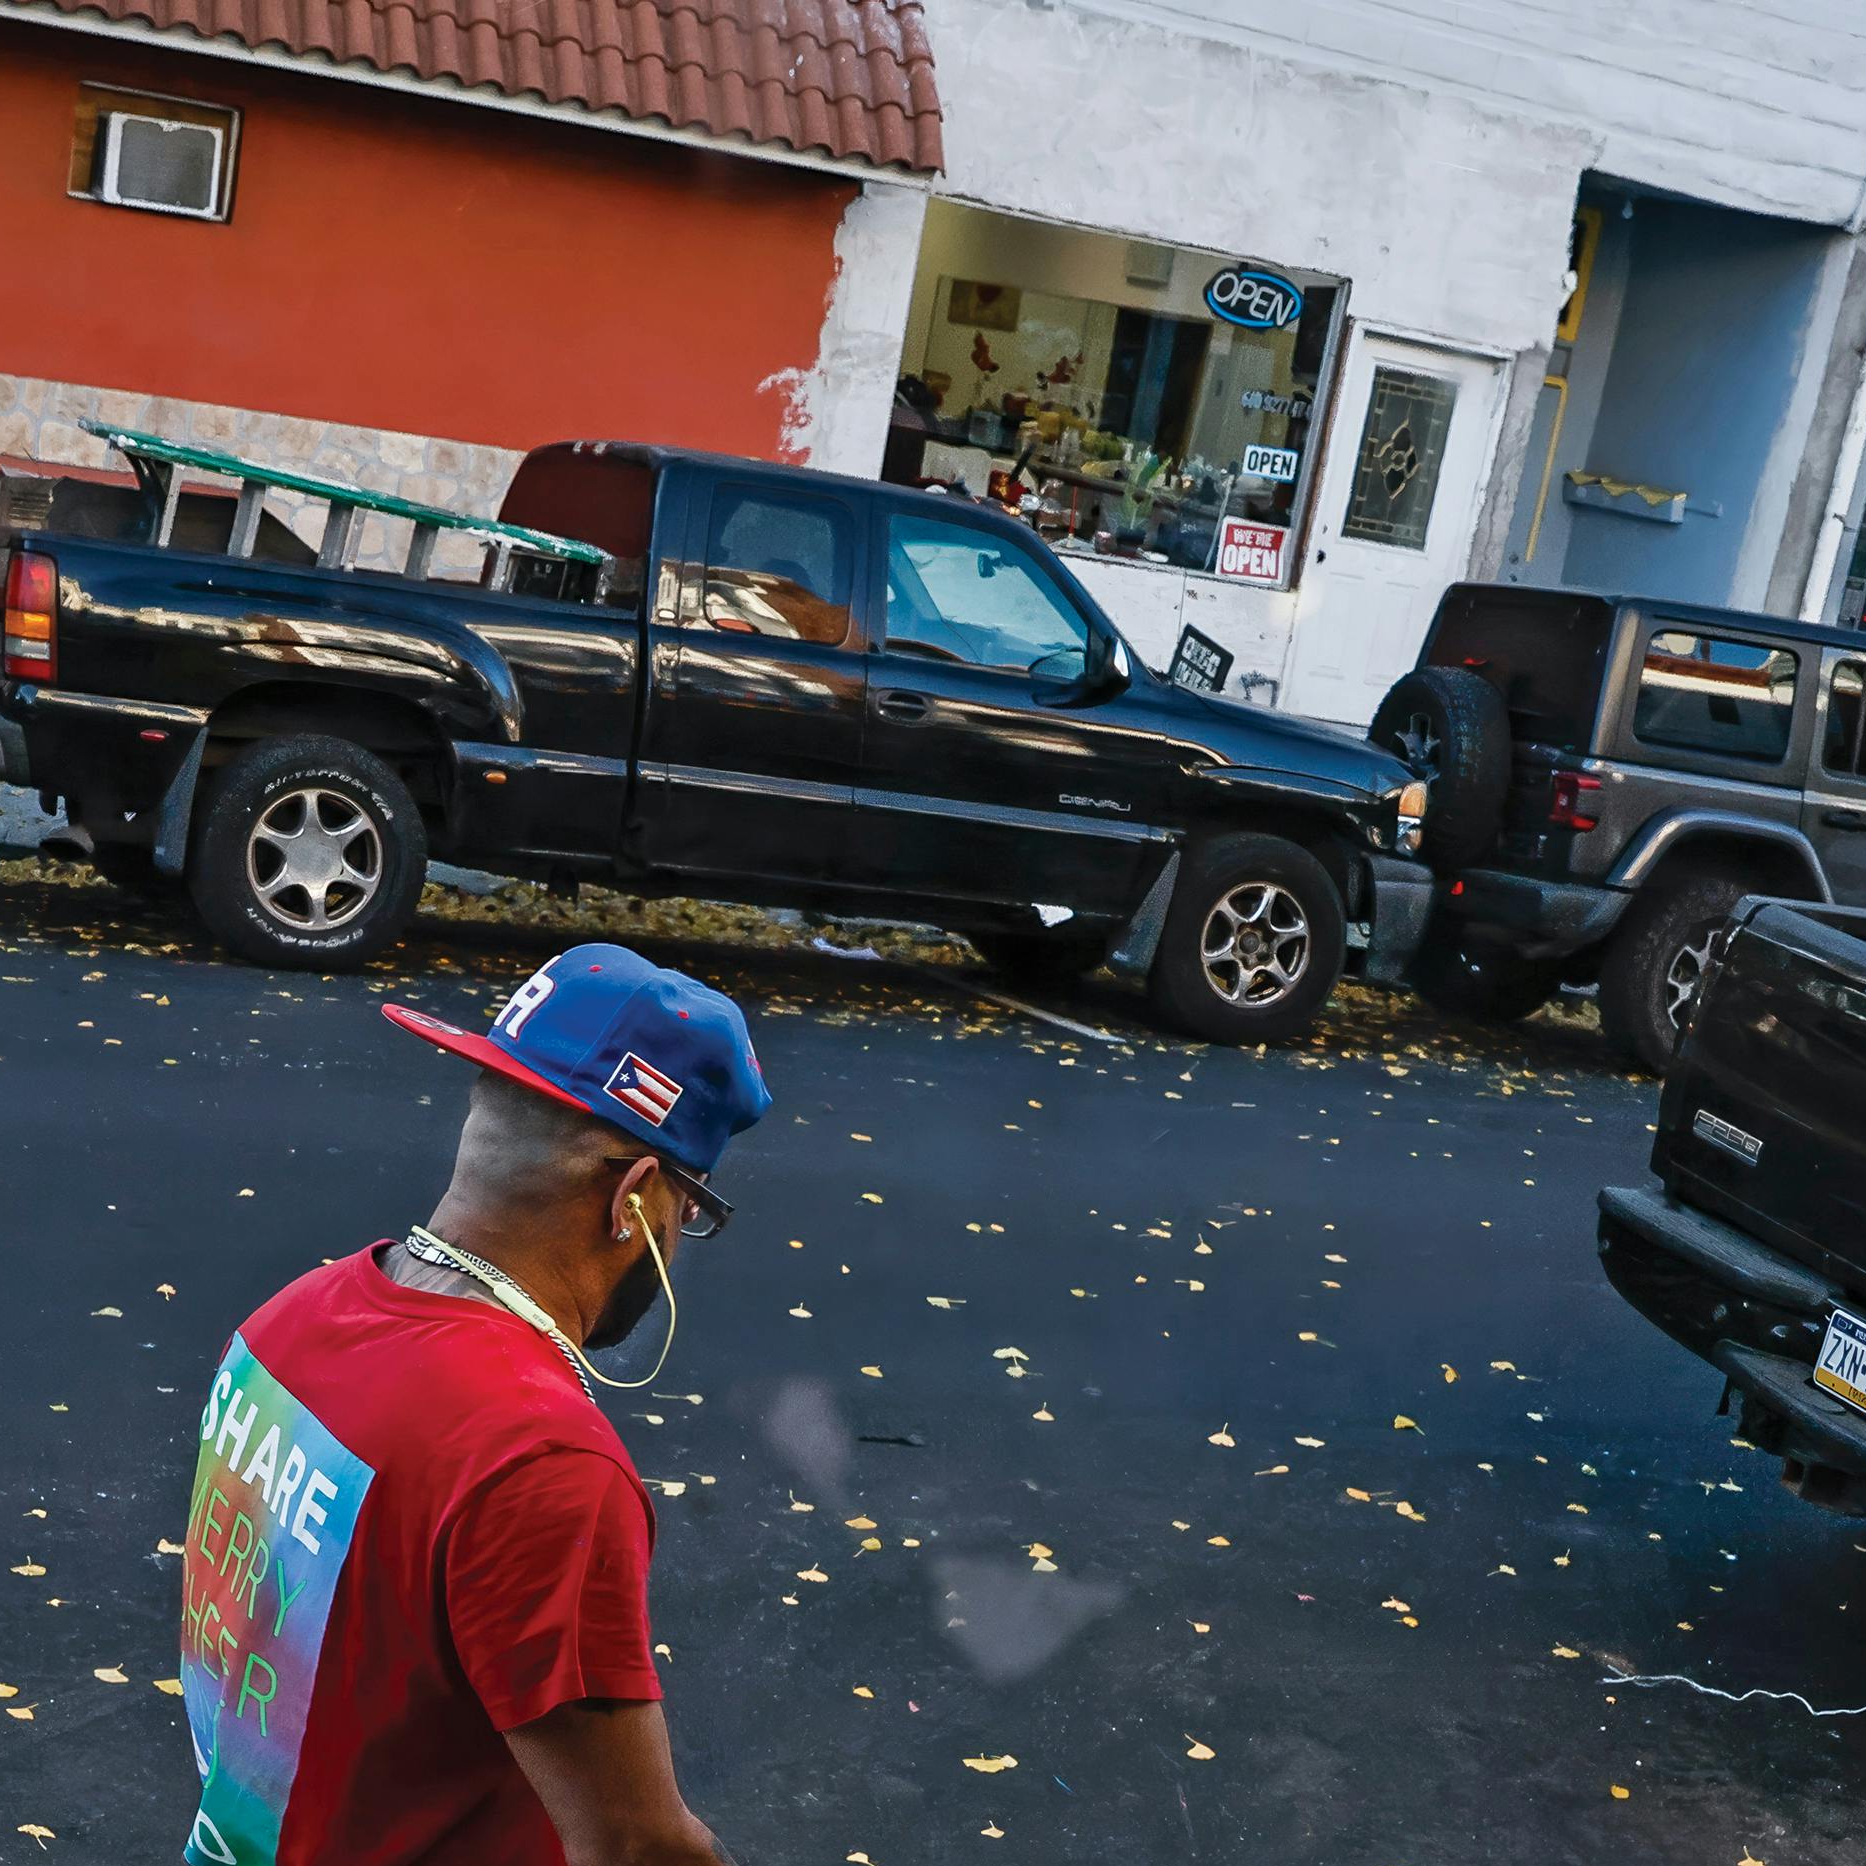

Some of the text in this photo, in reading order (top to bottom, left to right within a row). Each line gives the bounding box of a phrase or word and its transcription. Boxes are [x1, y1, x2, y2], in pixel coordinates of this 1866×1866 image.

[1212, 272, 1294, 326] OPEN
[1247, 450, 1293, 476] OPEN
[1222, 546, 1277, 577] OPEN
[202, 1370, 338, 1556] SHARE
